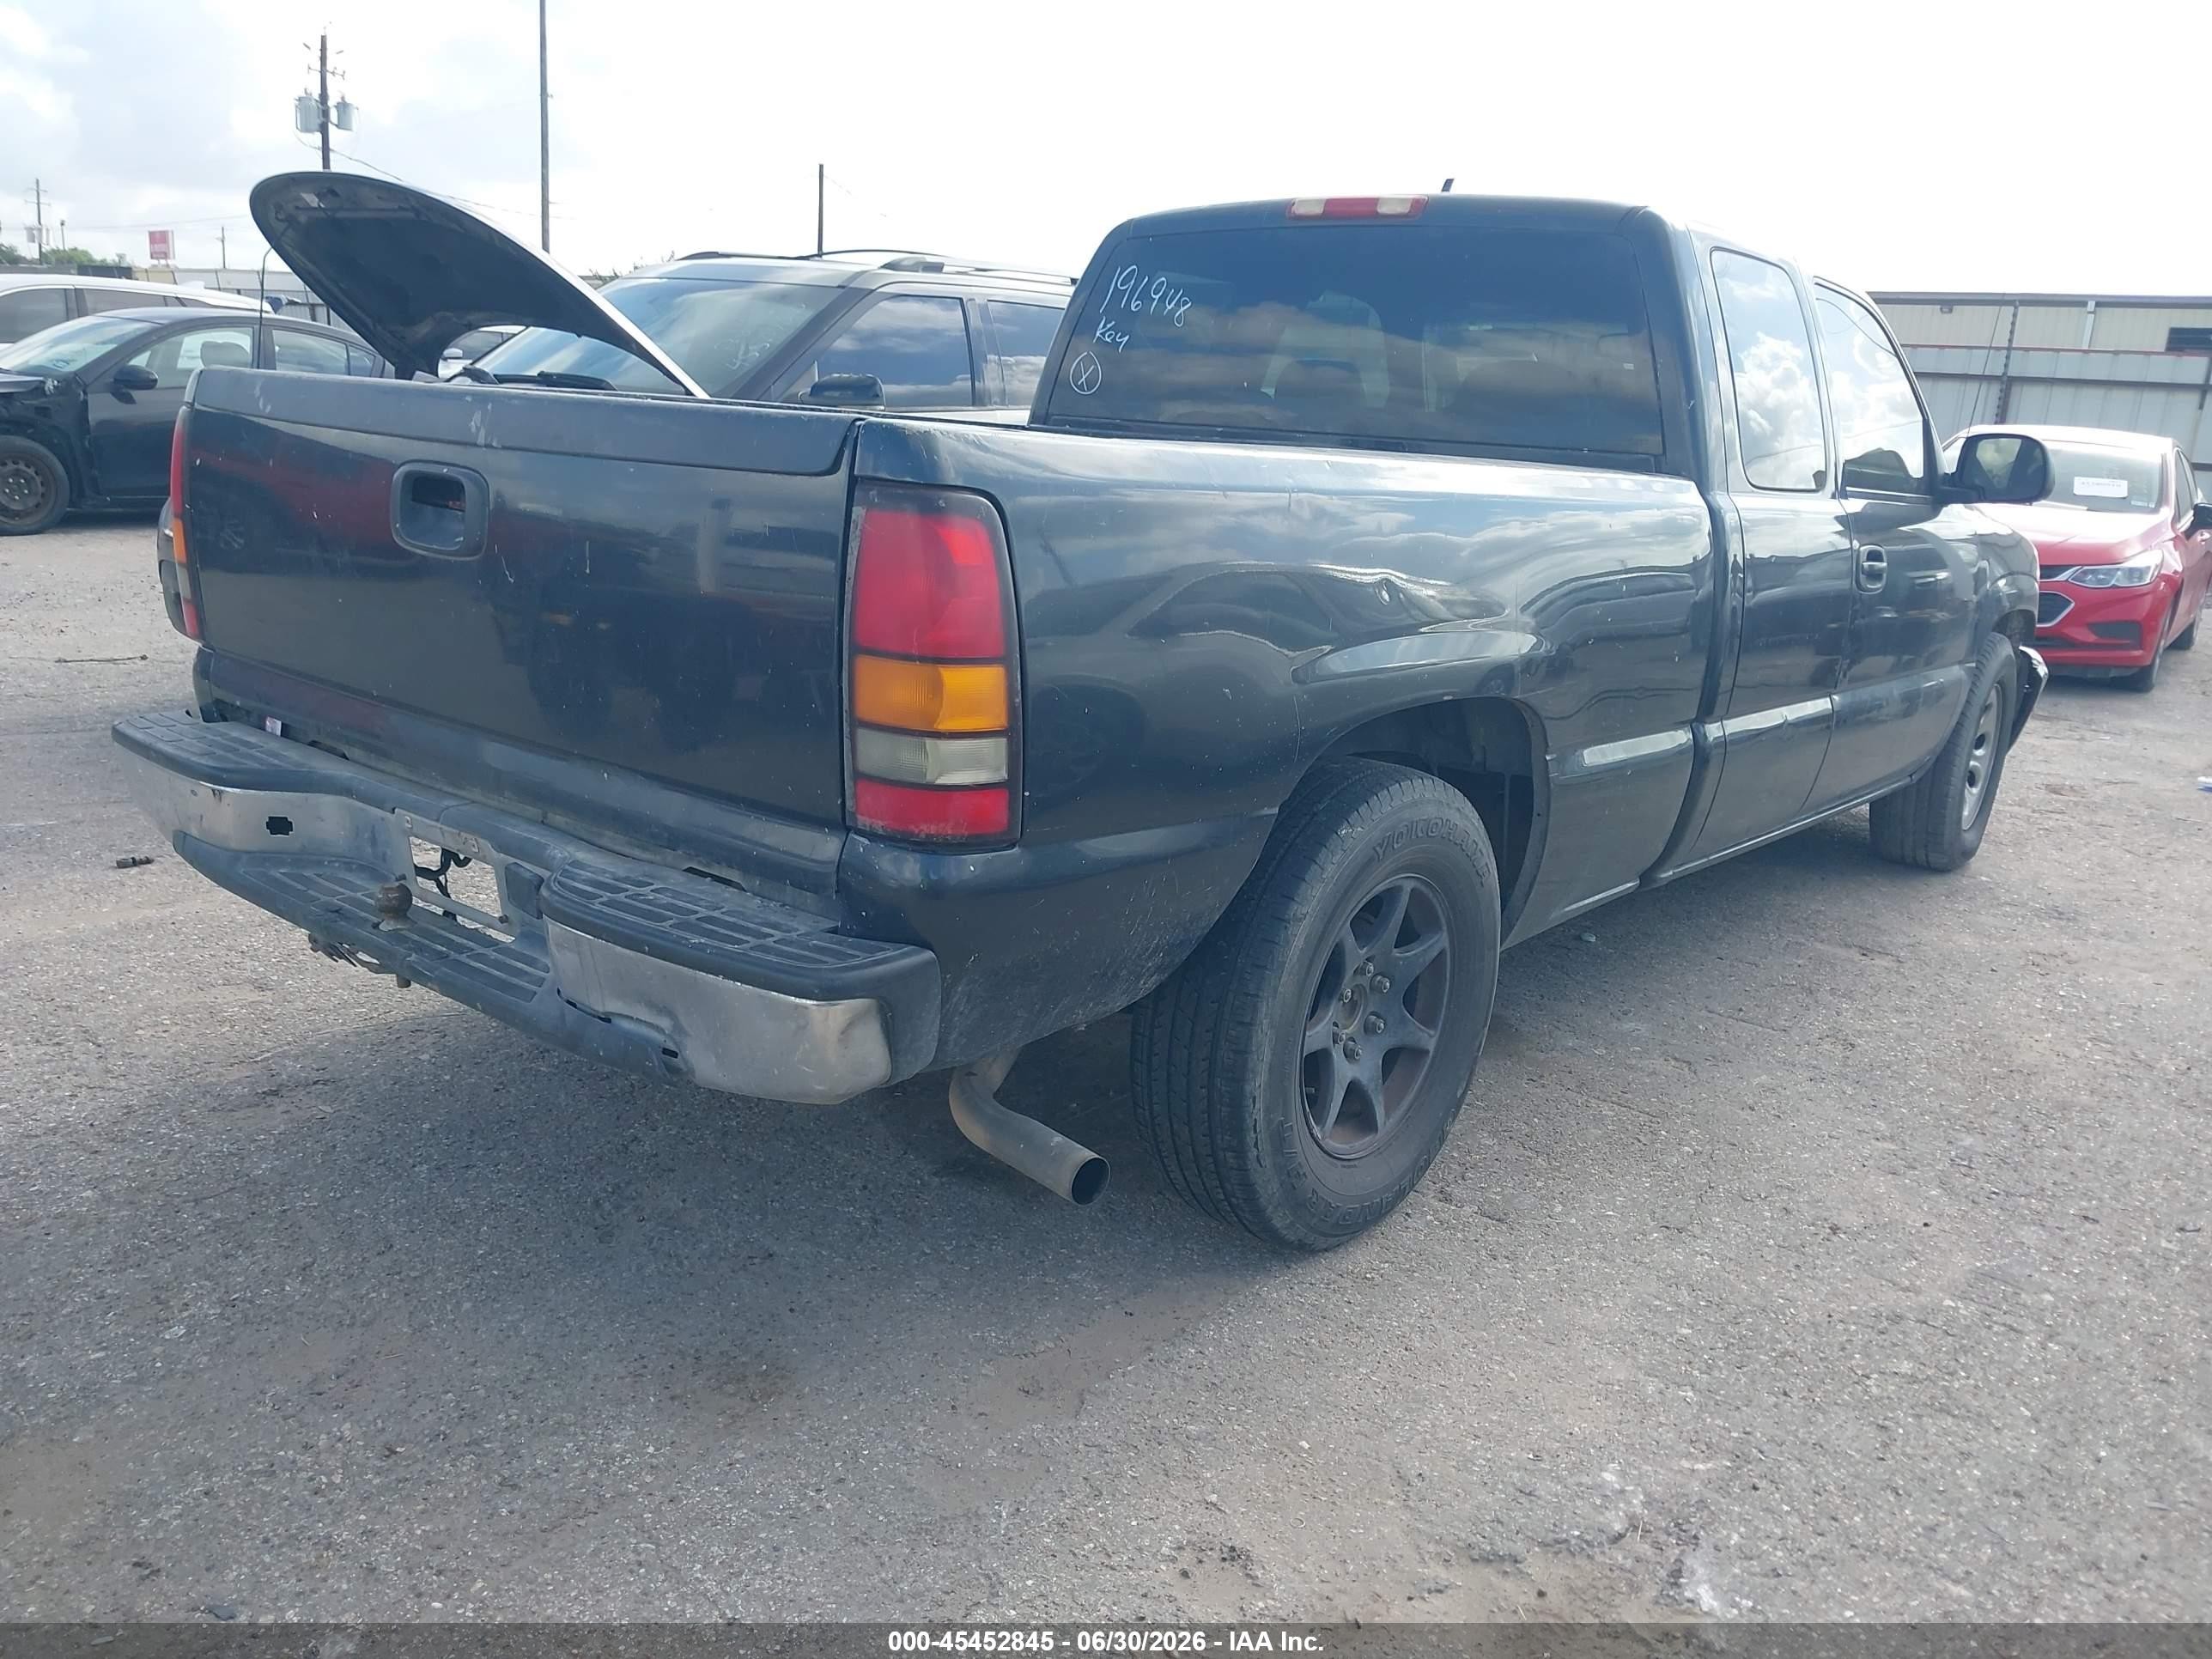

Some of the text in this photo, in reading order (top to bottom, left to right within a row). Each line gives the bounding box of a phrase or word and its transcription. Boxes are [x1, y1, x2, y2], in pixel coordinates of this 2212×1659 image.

[1099, 264, 1192, 327] 196948
[1093, 315, 1130, 353] Key
[1372, 817, 1491, 888] YOKOHAMA
